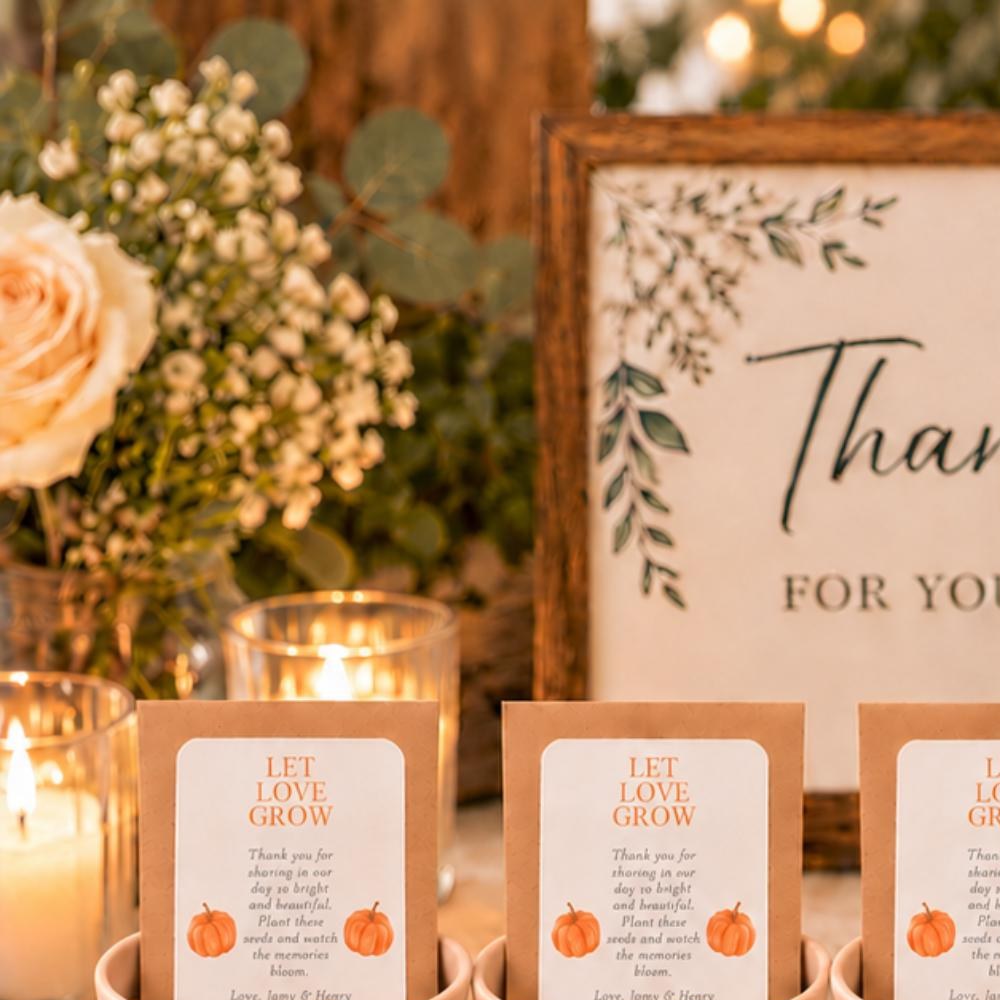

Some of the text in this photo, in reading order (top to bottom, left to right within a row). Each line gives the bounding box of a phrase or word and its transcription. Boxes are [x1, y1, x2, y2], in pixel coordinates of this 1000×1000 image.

[781, 573, 891, 613] FOR
[267, 756, 316, 777] LET
[629, 756, 679, 778] LET
[257, 780, 327, 802] LOVE
[620, 781, 690, 802] LOVE
[247, 804, 333, 826] GROW
[612, 805, 696, 826] GROW
[249, 848, 334, 864] Thank you for
[612, 848, 696, 864] Thank you for
[612, 865, 696, 880] sharing in our
[251, 882, 329, 897] day so bright
[248, 898, 332, 913] and beautiful.
[616, 948, 692, 960] the memories
[972, 948, 990, 960] the
[300, 989, 312, 1000] &
[663, 989, 675, 1000] &
